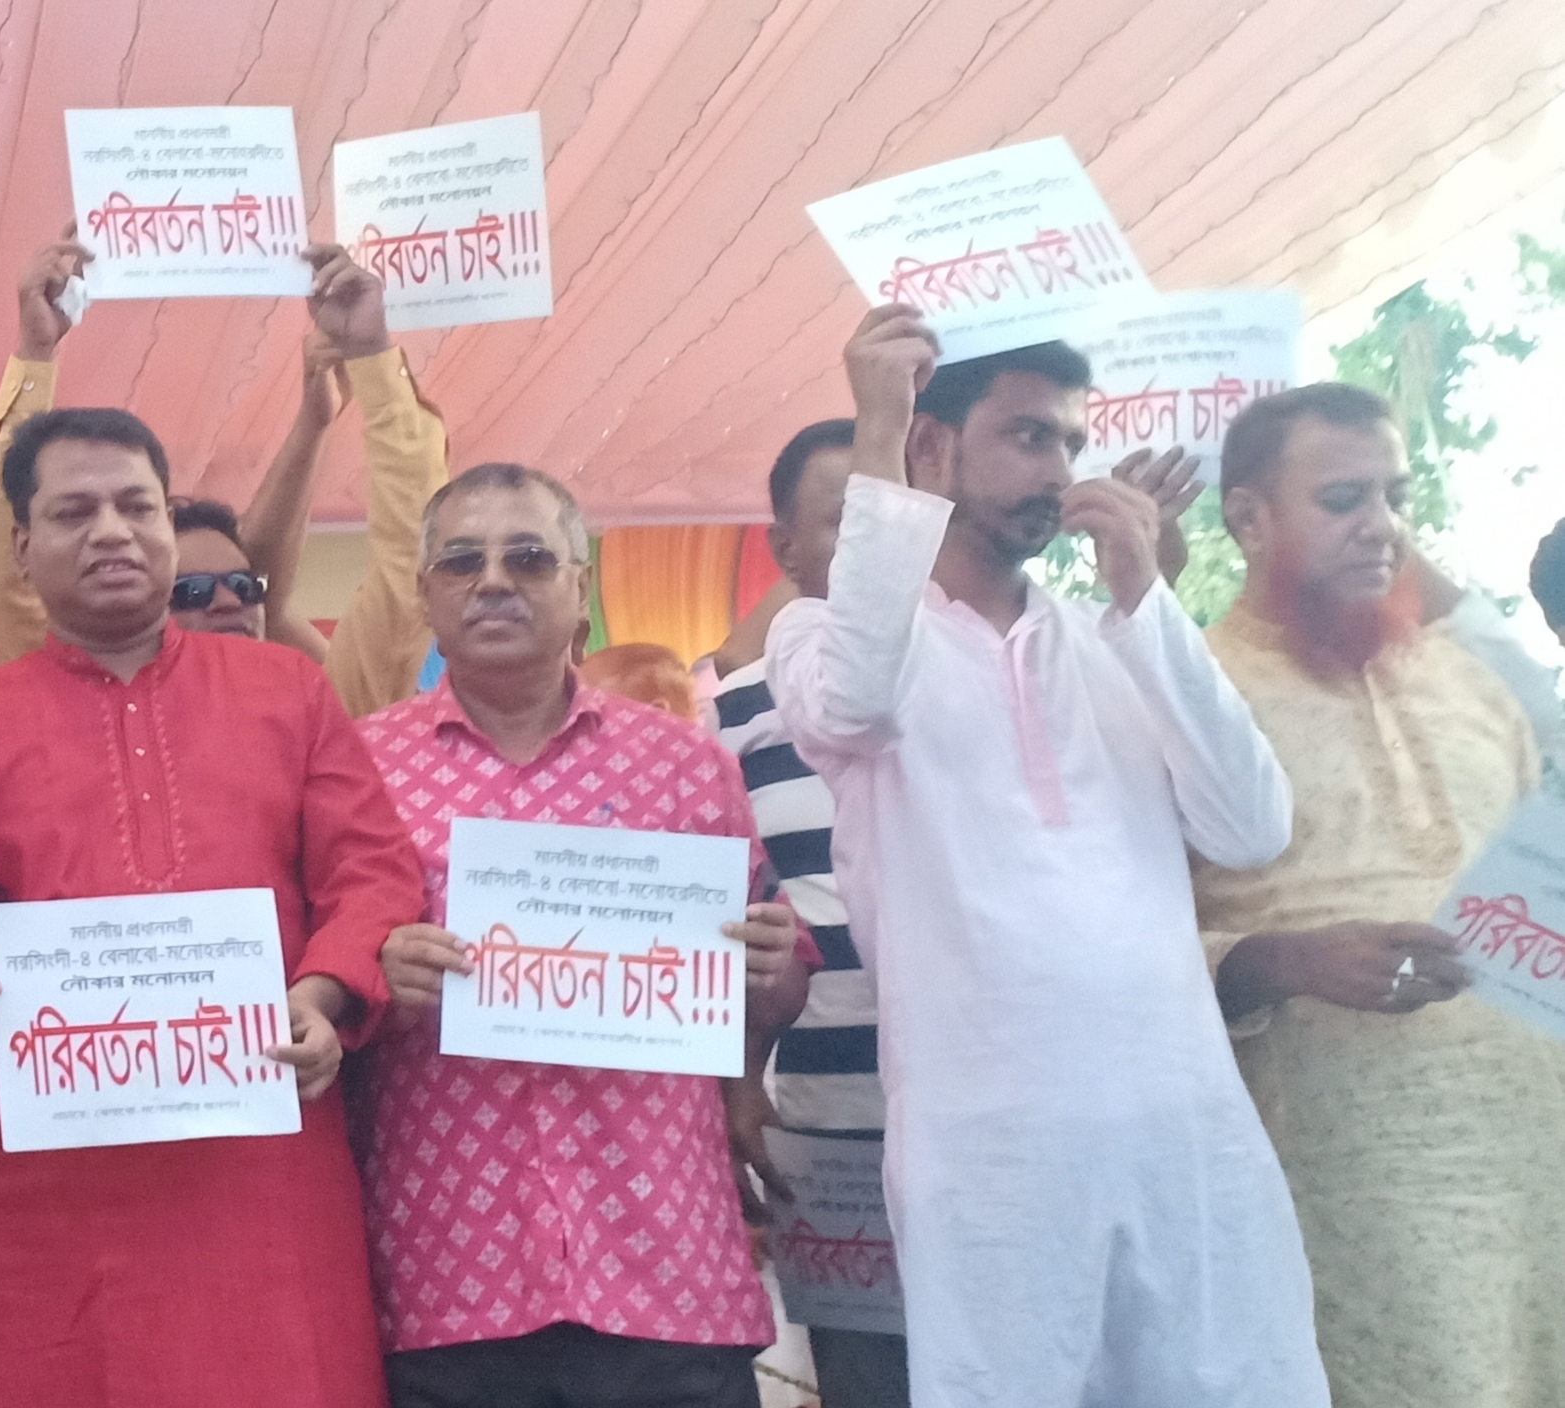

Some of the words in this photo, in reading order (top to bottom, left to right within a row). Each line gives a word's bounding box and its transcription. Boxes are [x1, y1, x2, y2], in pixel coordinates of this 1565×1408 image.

[88, 187, 207, 259] পরিবর্তন
[1084, 372, 1180, 452] রিবর্তন
[464, 923, 609, 1018] পরিবর্তন
[10, 997, 160, 1096] পরিবর্তন
